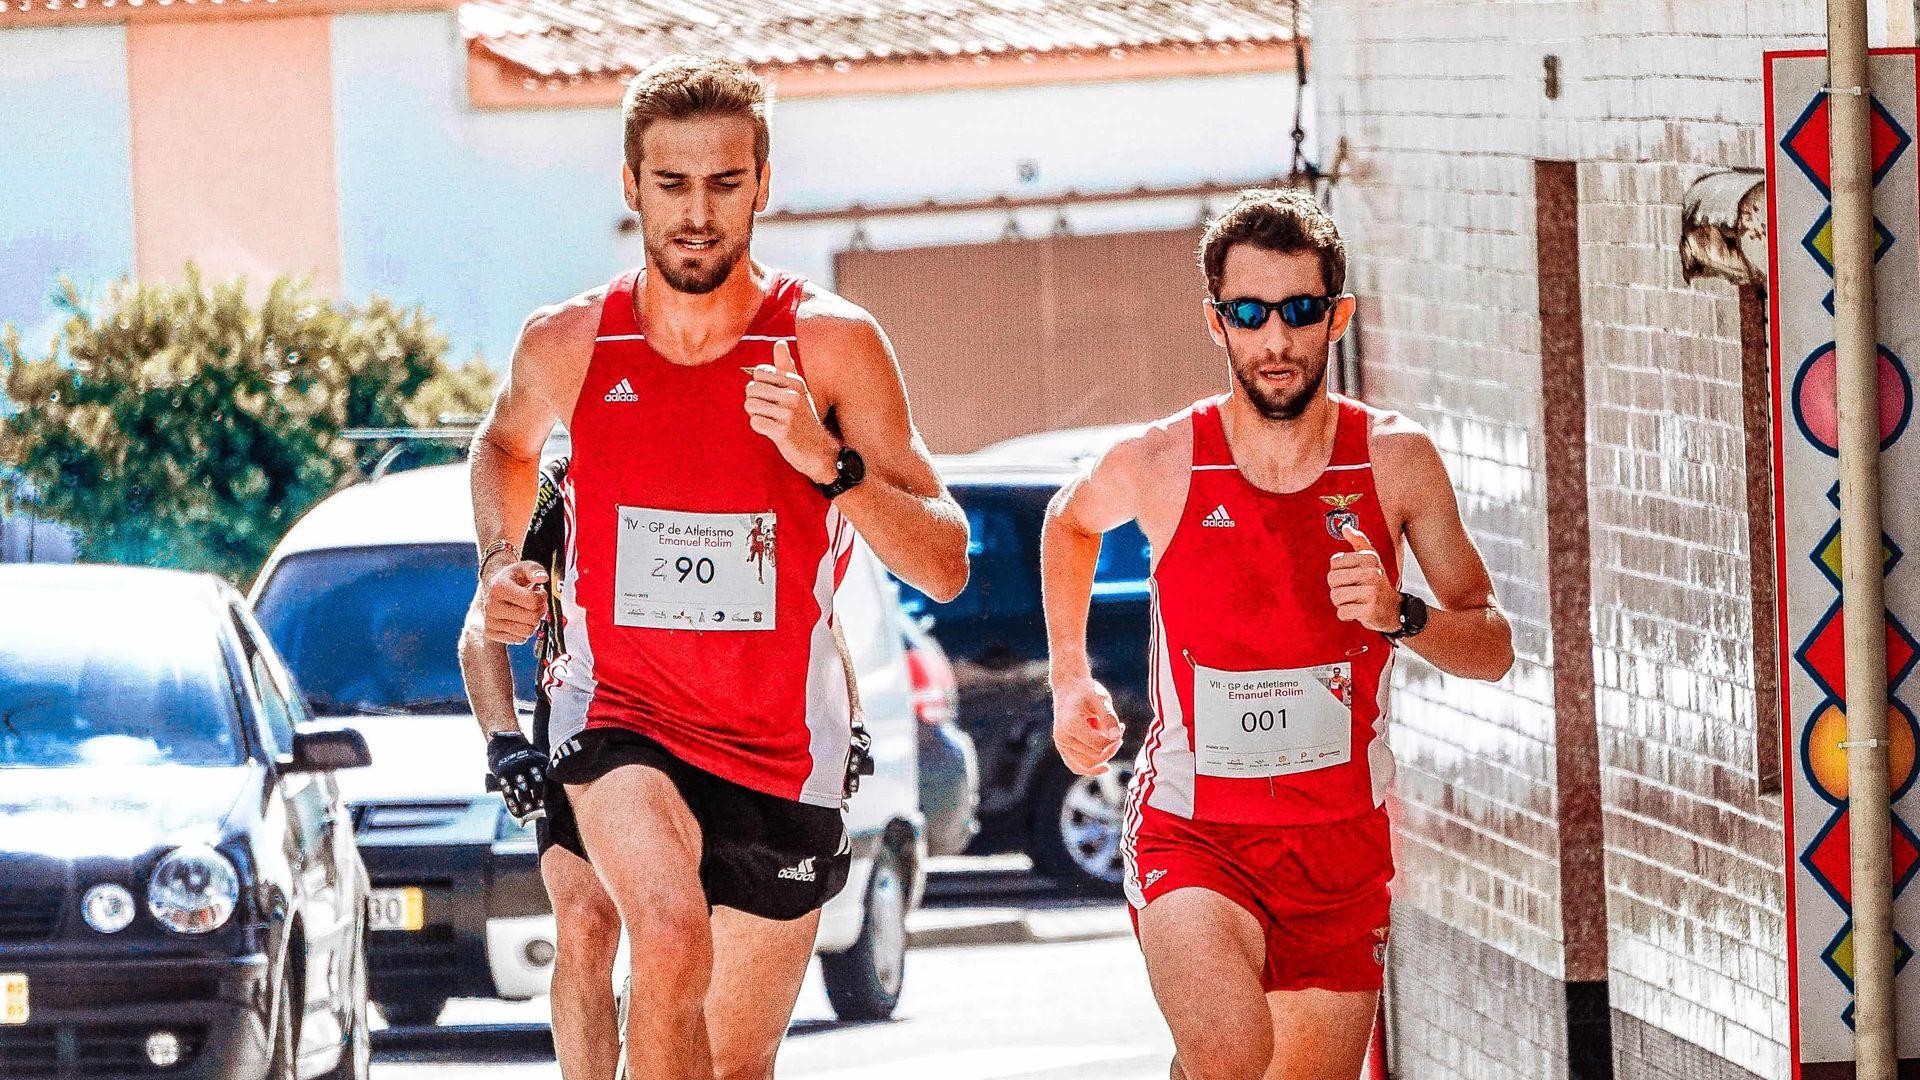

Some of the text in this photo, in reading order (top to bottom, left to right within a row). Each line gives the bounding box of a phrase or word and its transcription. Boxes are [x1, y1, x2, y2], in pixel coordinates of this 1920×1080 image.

[604, 392, 639, 402] adidas
[648, 521, 665, 533] GP
[667, 524, 681, 535] de
[684, 525, 734, 538] Atletismo
[1202, 519, 1236, 528] adidas
[659, 535, 732, 548] Emanuel Rolim
[1209, 680, 1221, 689] VII
[1228, 682, 1241, 691] GP
[1243, 681, 1255, 691] de
[1256, 680, 1299, 690] Atletismo
[1228, 687, 1304, 700] Emanuel Rolim
[1241, 708, 1287, 733] 001
[777, 867, 817, 882] adidas
